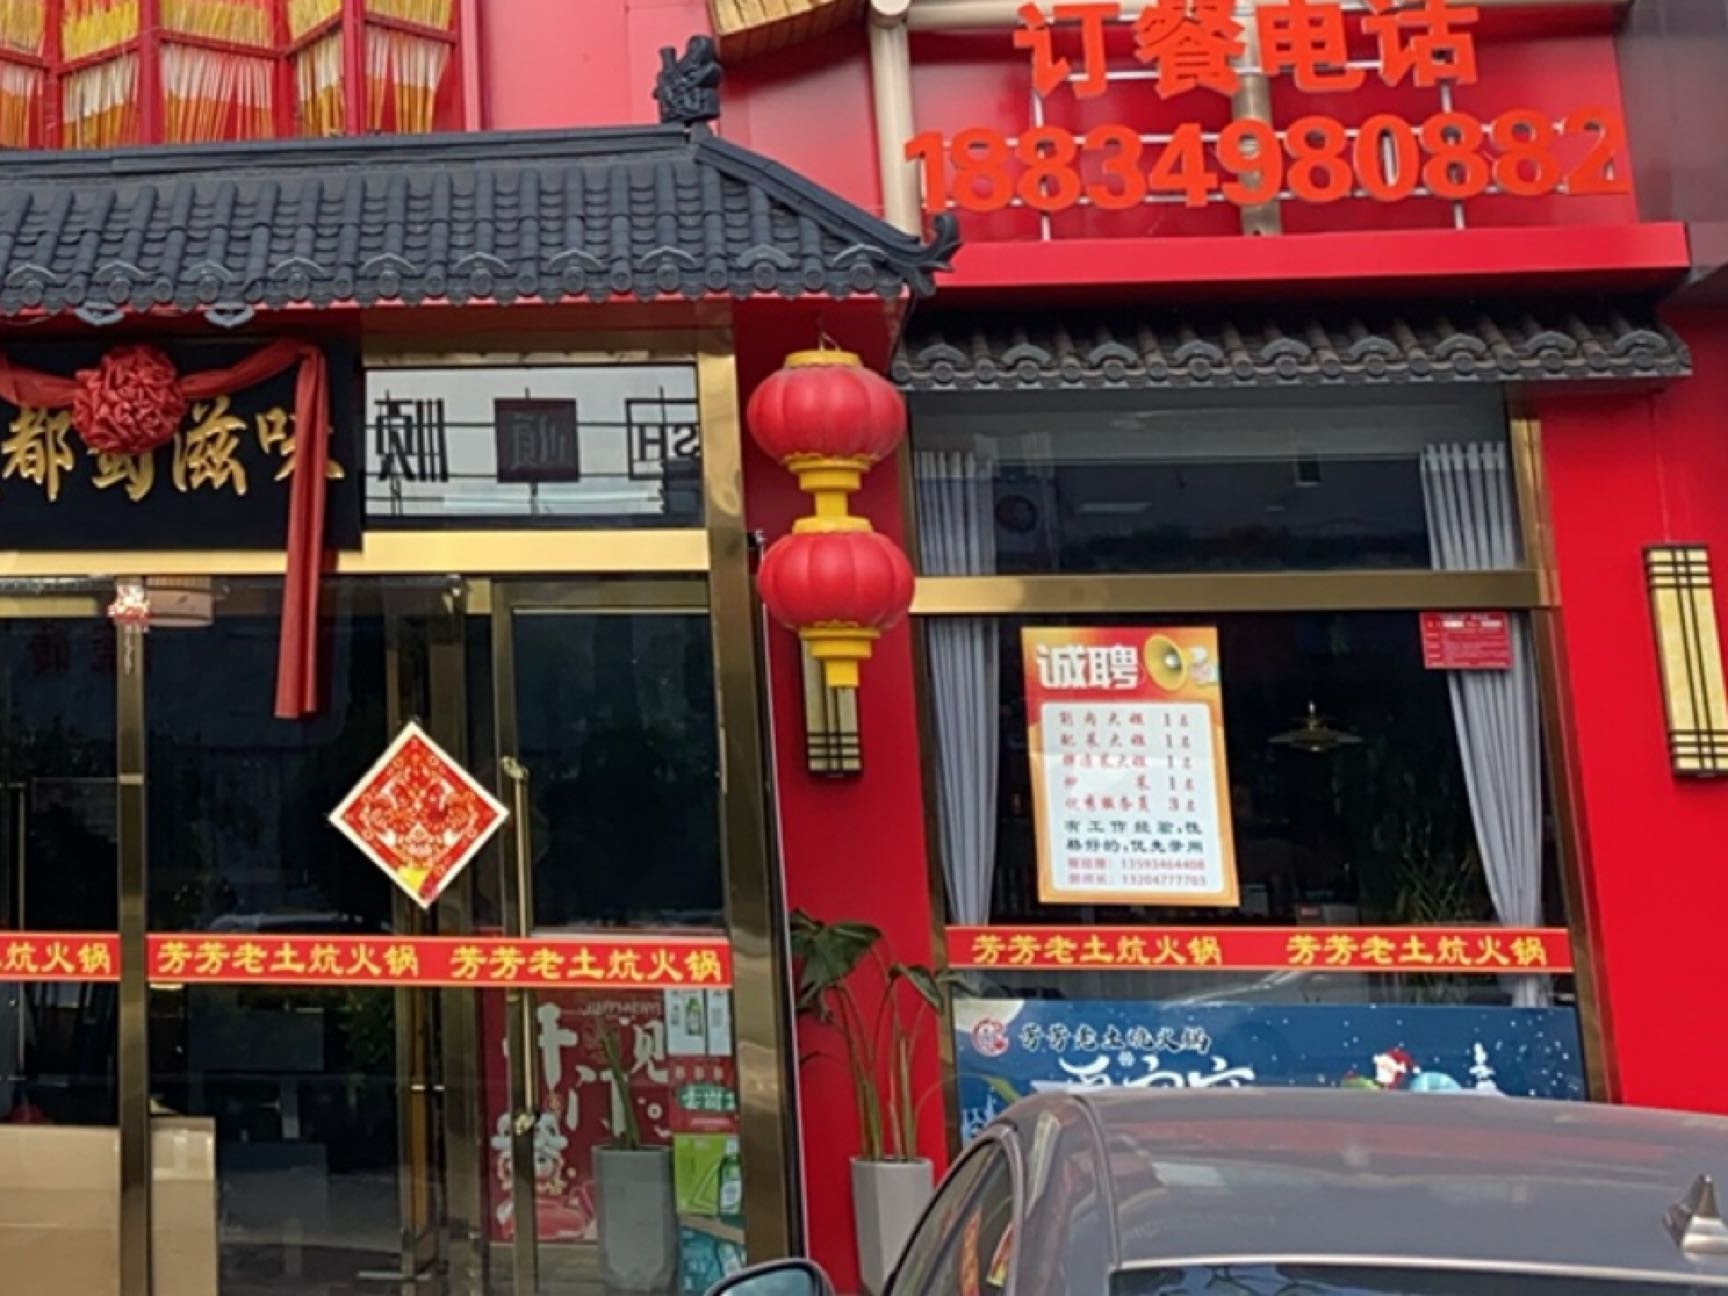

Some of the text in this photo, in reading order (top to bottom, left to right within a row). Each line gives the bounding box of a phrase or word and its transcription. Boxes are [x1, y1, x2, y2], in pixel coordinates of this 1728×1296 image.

[905, 108, 1631, 216] 18834980882
[1036, 644, 1138, 690] 诚聘
[156, 942, 723, 982] 芳芳老土炕火锅 芳芳老土炕火锅
[972, 935, 1548, 966] 芳芳老土炕火锅 芳芳老土炕火锅
